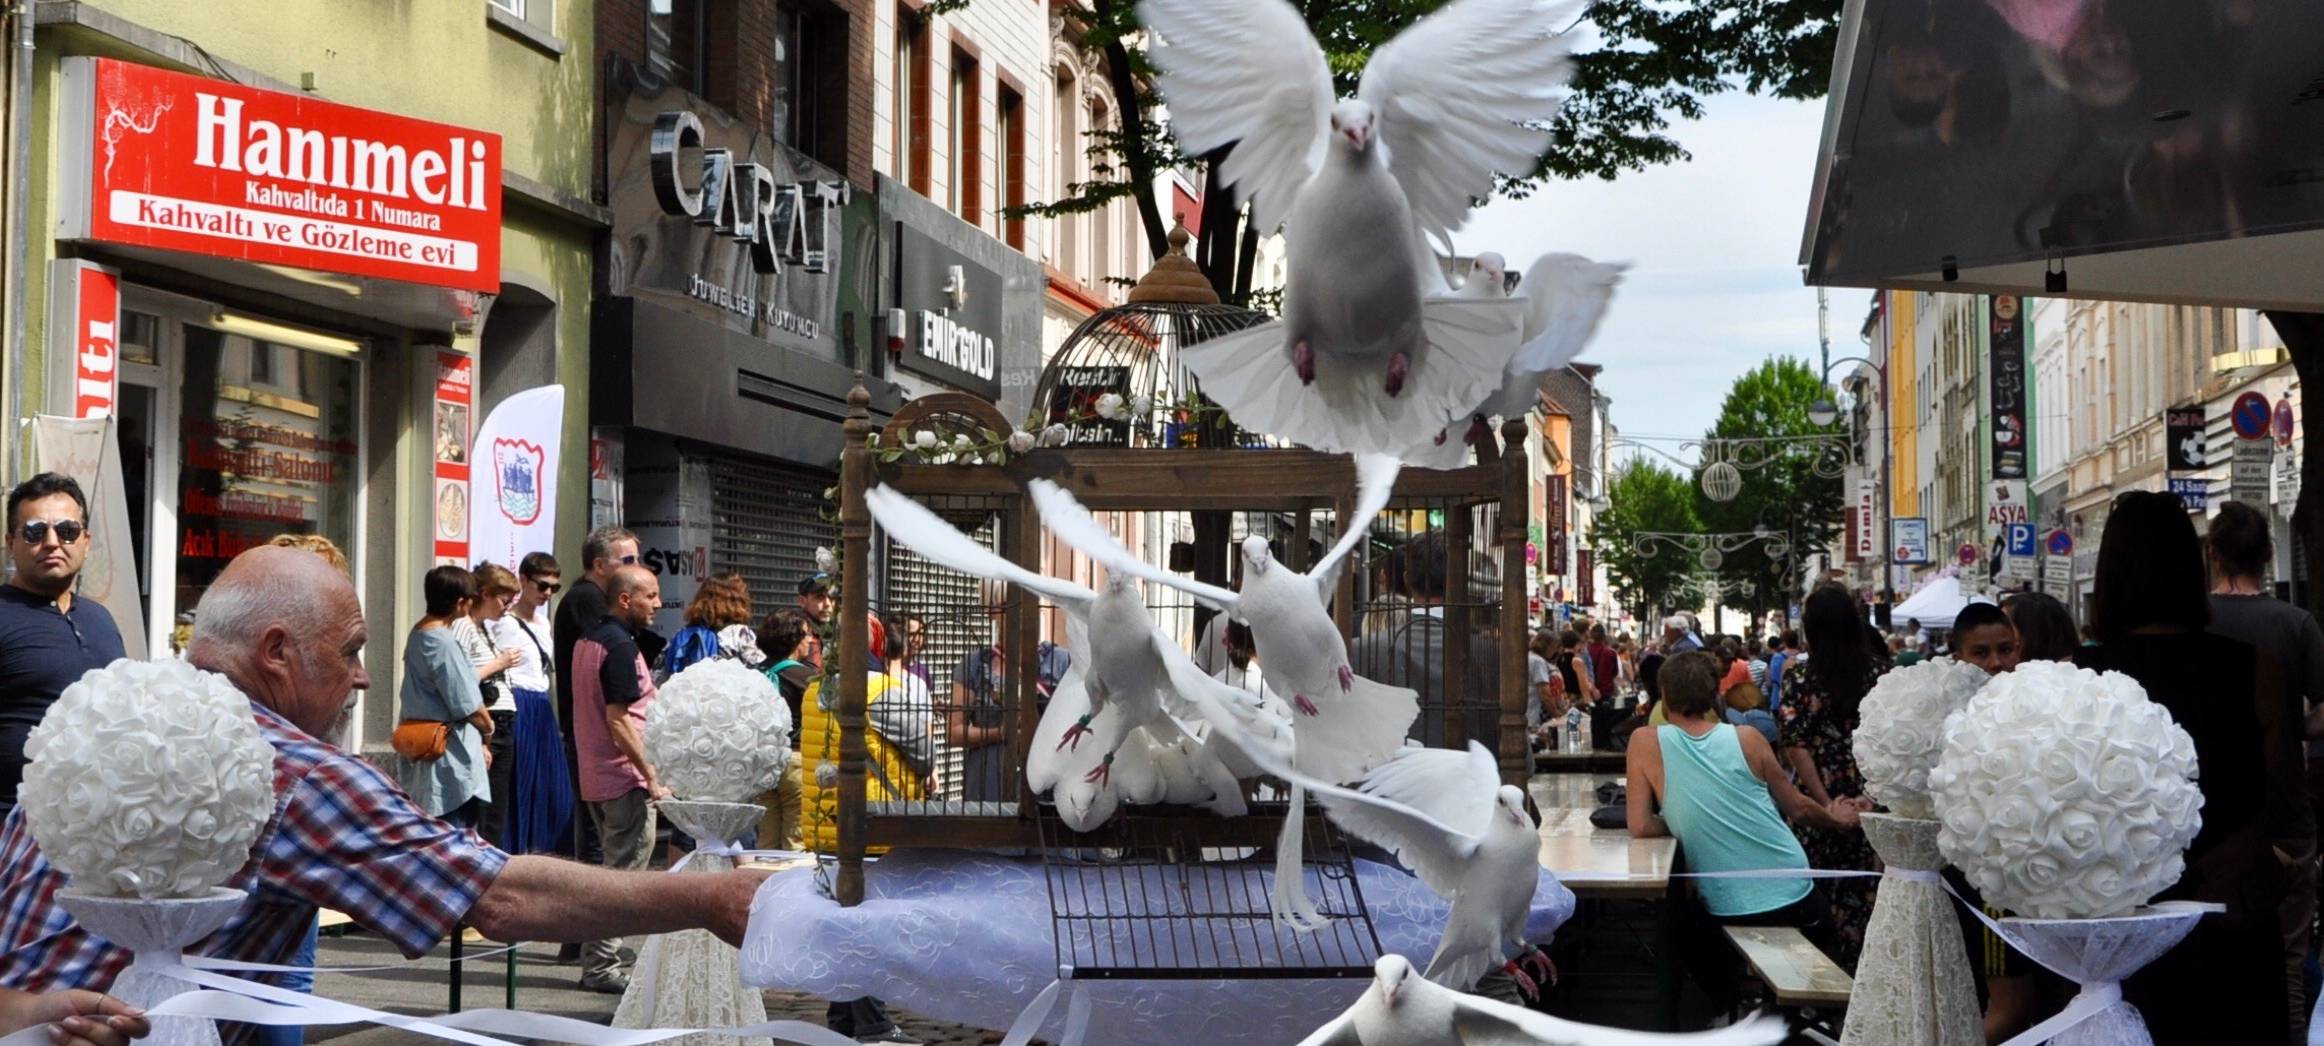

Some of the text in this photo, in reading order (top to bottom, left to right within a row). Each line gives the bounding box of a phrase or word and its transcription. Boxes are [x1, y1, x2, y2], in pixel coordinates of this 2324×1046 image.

[194, 92, 488, 212] Hanımeli
[137, 199, 456, 266] Kahvaltı ve Gözleme evi
[244, 180, 442, 232] Kahvaltıda 1 Numara
[1860, 494, 1873, 553] Damla
[1988, 505, 2027, 525] ASYA
[2012, 525, 2029, 552] P
